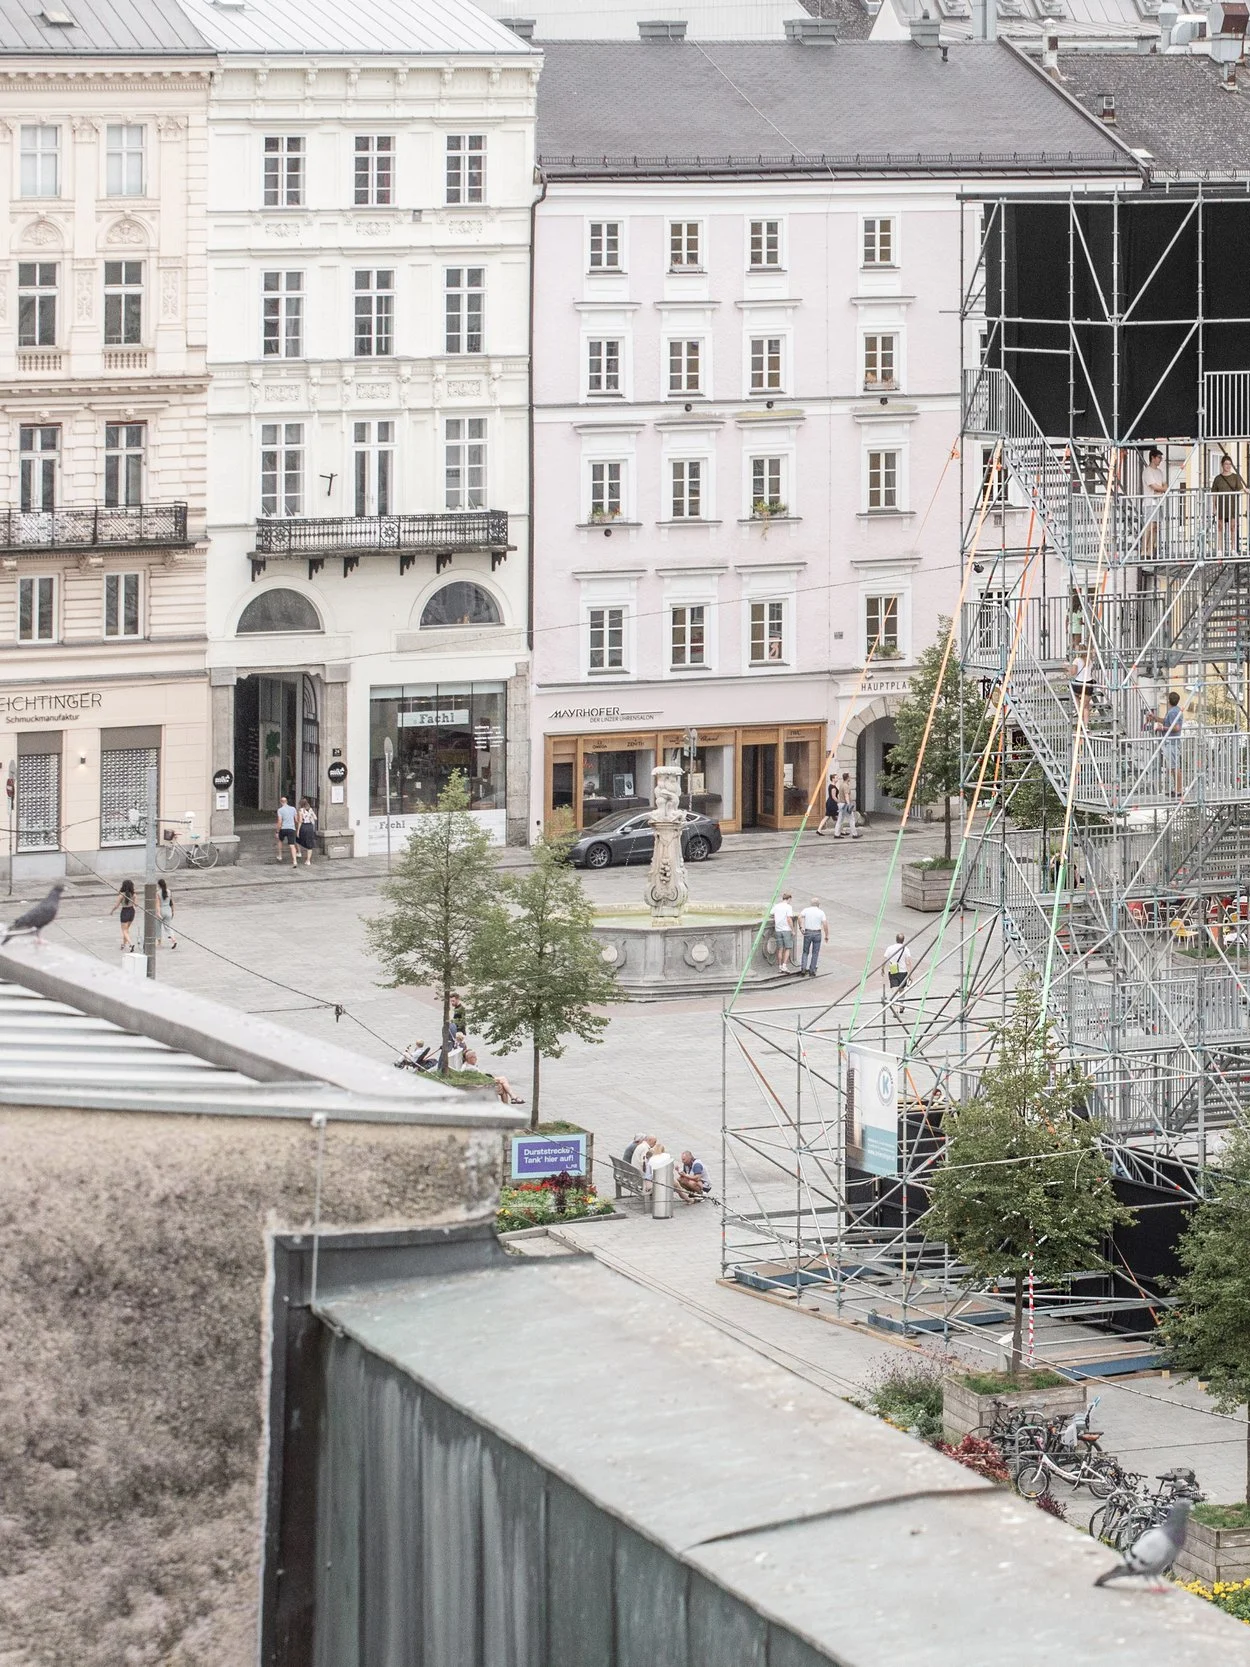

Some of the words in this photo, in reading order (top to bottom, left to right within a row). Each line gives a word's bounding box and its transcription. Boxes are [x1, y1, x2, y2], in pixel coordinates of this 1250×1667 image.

[861, 681, 911, 692] HAUPTPLA
[419, 712, 455, 724] Fachl
[549, 706, 621, 719] MAYRHOFER
[6, 713, 80, 724] Schmuckmanufaktur
